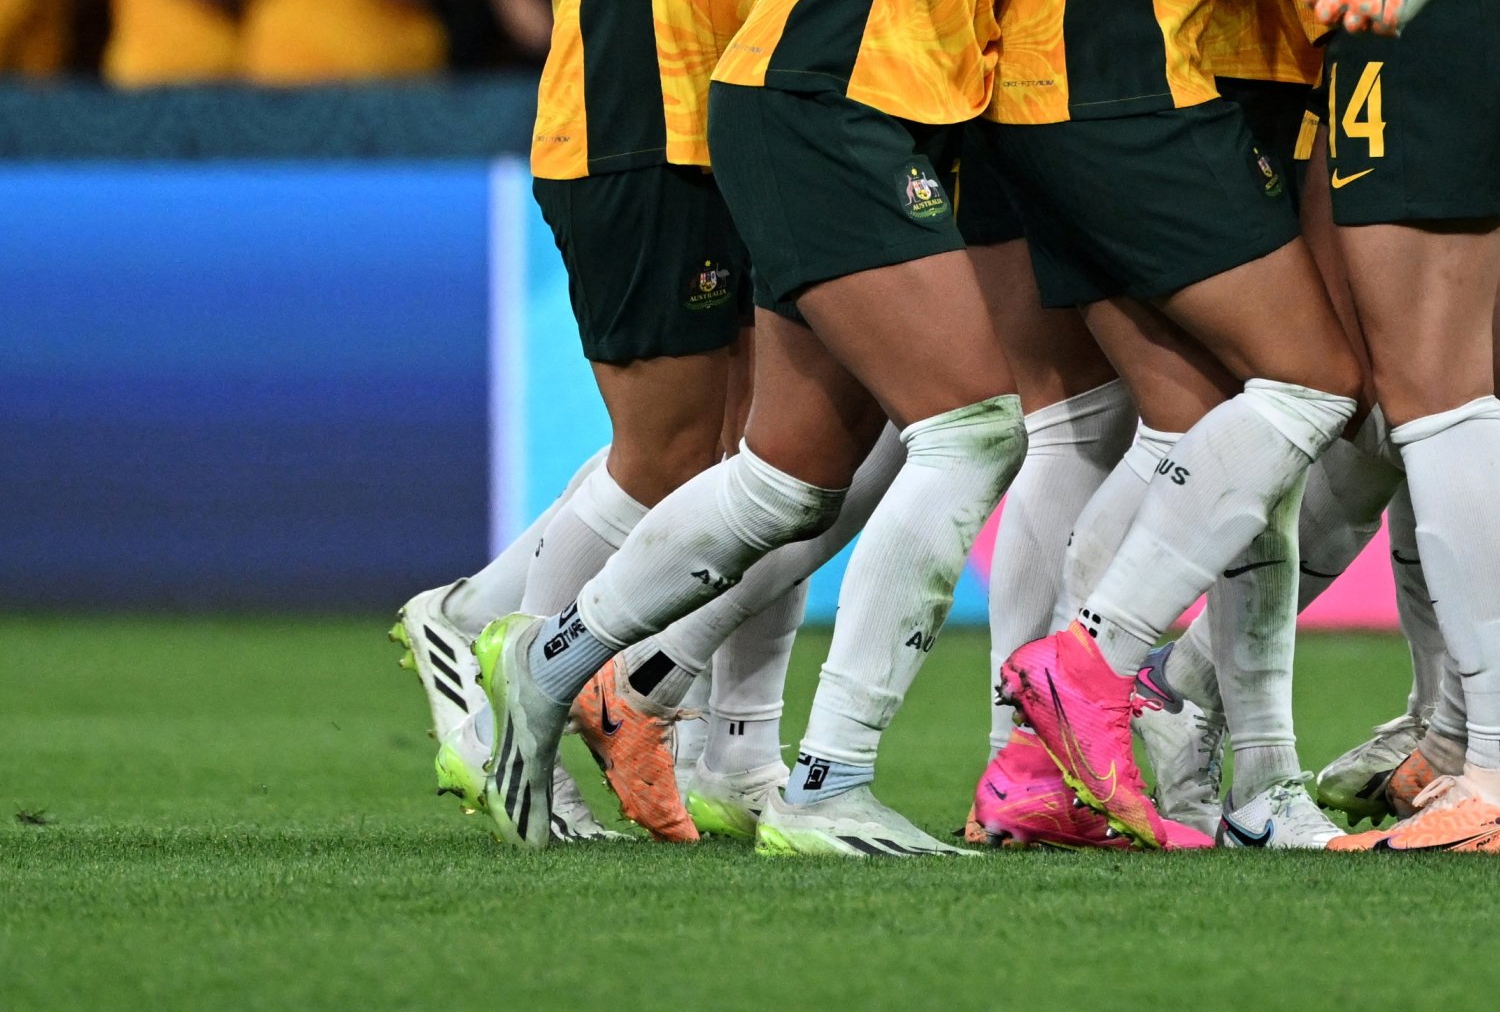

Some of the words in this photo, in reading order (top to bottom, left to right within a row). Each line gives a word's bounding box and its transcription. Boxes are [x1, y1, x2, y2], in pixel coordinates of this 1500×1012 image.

[1328, 61, 1386, 158] 14
[912, 198, 943, 211] AUSTRALIA
[690, 288, 727, 302] AUSTRALIA
[1154, 458, 1191, 486] US
